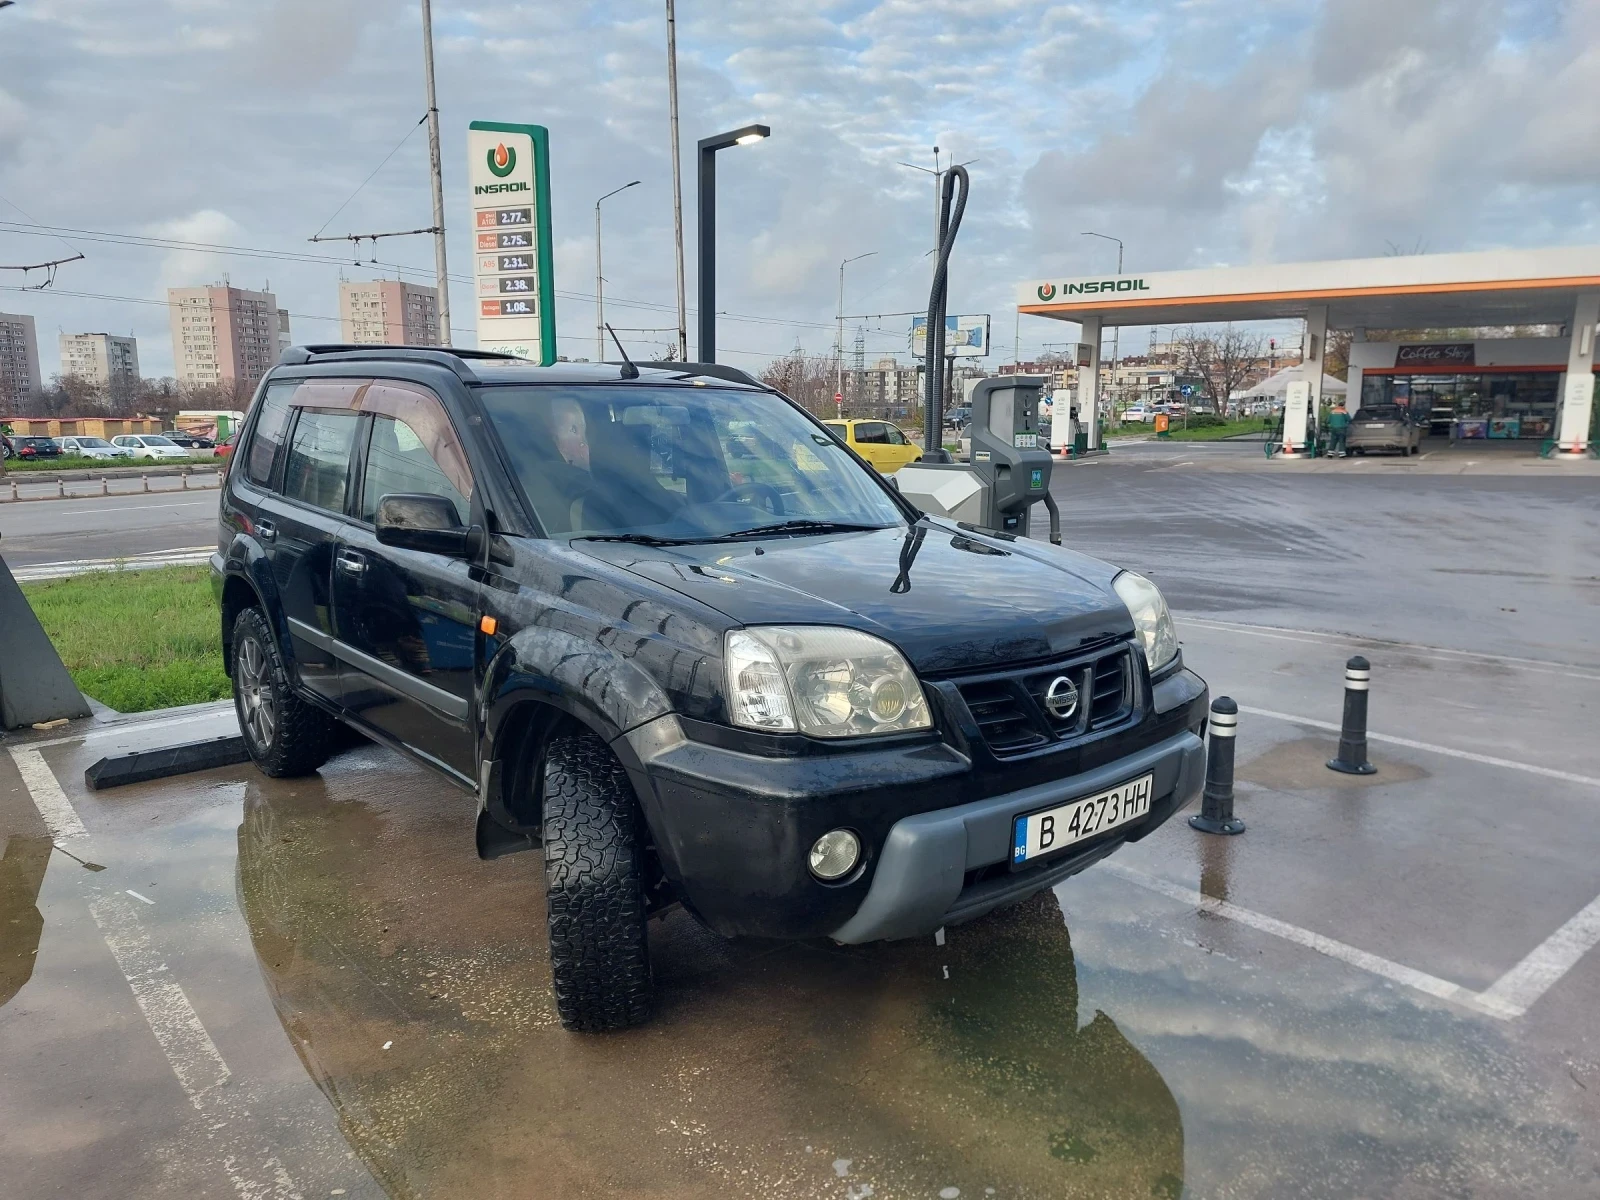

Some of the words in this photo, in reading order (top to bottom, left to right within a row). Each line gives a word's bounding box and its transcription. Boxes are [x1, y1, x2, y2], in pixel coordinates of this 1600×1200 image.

[475, 182, 531, 195] INSAOIL
[501, 212, 521, 223] 2.77
[502, 235, 522, 246] 2.75
[483, 260, 495, 268] A95
[503, 257, 522, 268] 2.31
[505, 279, 525, 290] 2.38
[1063, 279, 1150, 295] INSAOIL
[505, 302, 525, 312] 1.08
[515, 345, 529, 357] Shop
[1400, 347, 1440, 360] Coffee
[1444, 345, 1471, 361] Shop
[1039, 816, 1055, 850] B
[1067, 793, 1119, 838] 4273
[1122, 780, 1149, 819] HH
[1014, 845, 1026, 857] BG
